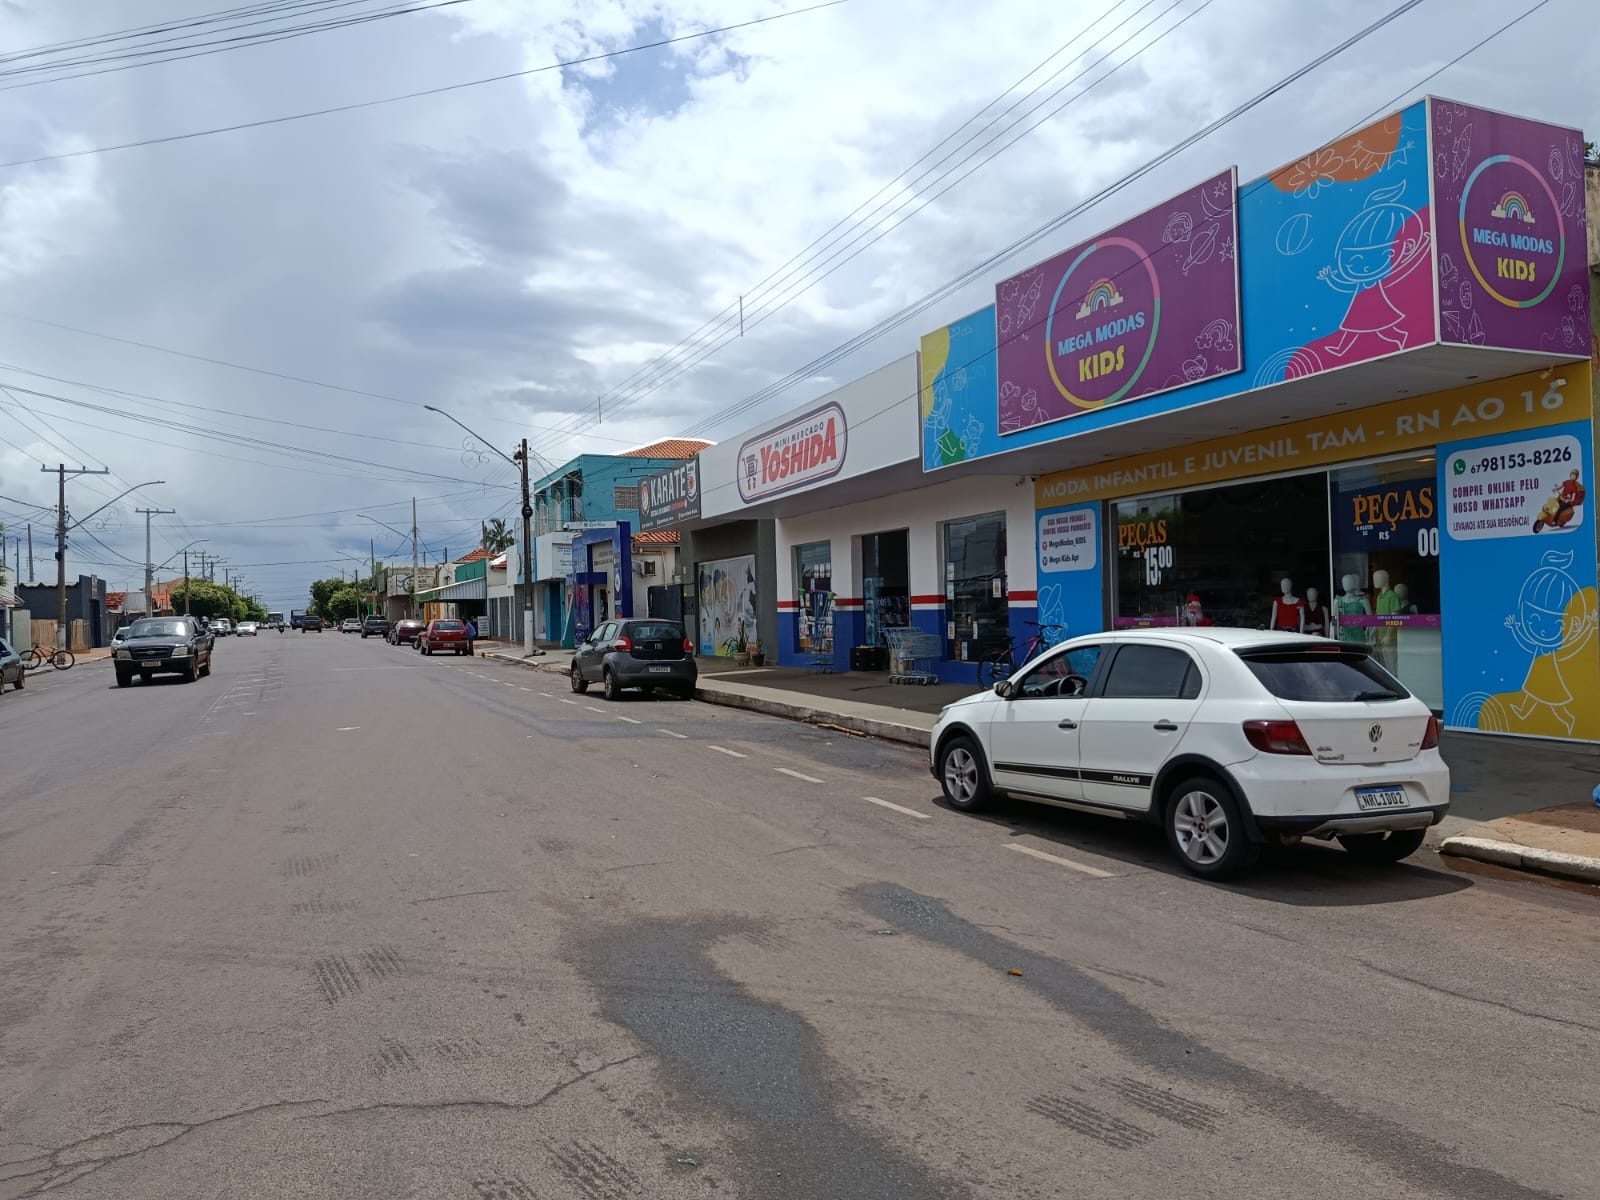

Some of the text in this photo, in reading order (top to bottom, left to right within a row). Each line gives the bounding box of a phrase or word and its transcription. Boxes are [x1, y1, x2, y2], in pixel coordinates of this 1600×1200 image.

[1473, 227, 1554, 254] MEGA MODAS
[1497, 257, 1536, 282] KIDS
[1058, 312, 1145, 357] MEGA MODAS
[1079, 345, 1125, 382] KIDS
[774, 421, 825, 450] MINI MERCADO
[1042, 477, 1090, 499] MODA
[1094, 461, 1179, 490] INFANTIL
[1184, 456, 1196, 475] E
[1202, 437, 1300, 472] JUVENIL
[1306, 423, 1367, 452] TAM
[1396, 408, 1440, 437] RN
[1452, 397, 1505, 427] AO
[1521, 382, 1565, 414] 16
[760, 416, 837, 485] YOSHIDA
[650, 465, 687, 508] KARATE
[1452, 477, 1540, 499] COMPRE ONLINE PELO
[1353, 487, 1434, 532] PEÇAS
[1452, 495, 1526, 514] NOSSO WHATSAPP
[1118, 519, 1168, 553] PEÇAS
[1453, 519, 1476, 532] LEVAMOS
[1486, 518, 1497, 529] SUA
[1378, 527, 1440, 557] R$ 00
[1112, 775, 1140, 784] RALLYE
[1361, 791, 1405, 808] NRL1D02
